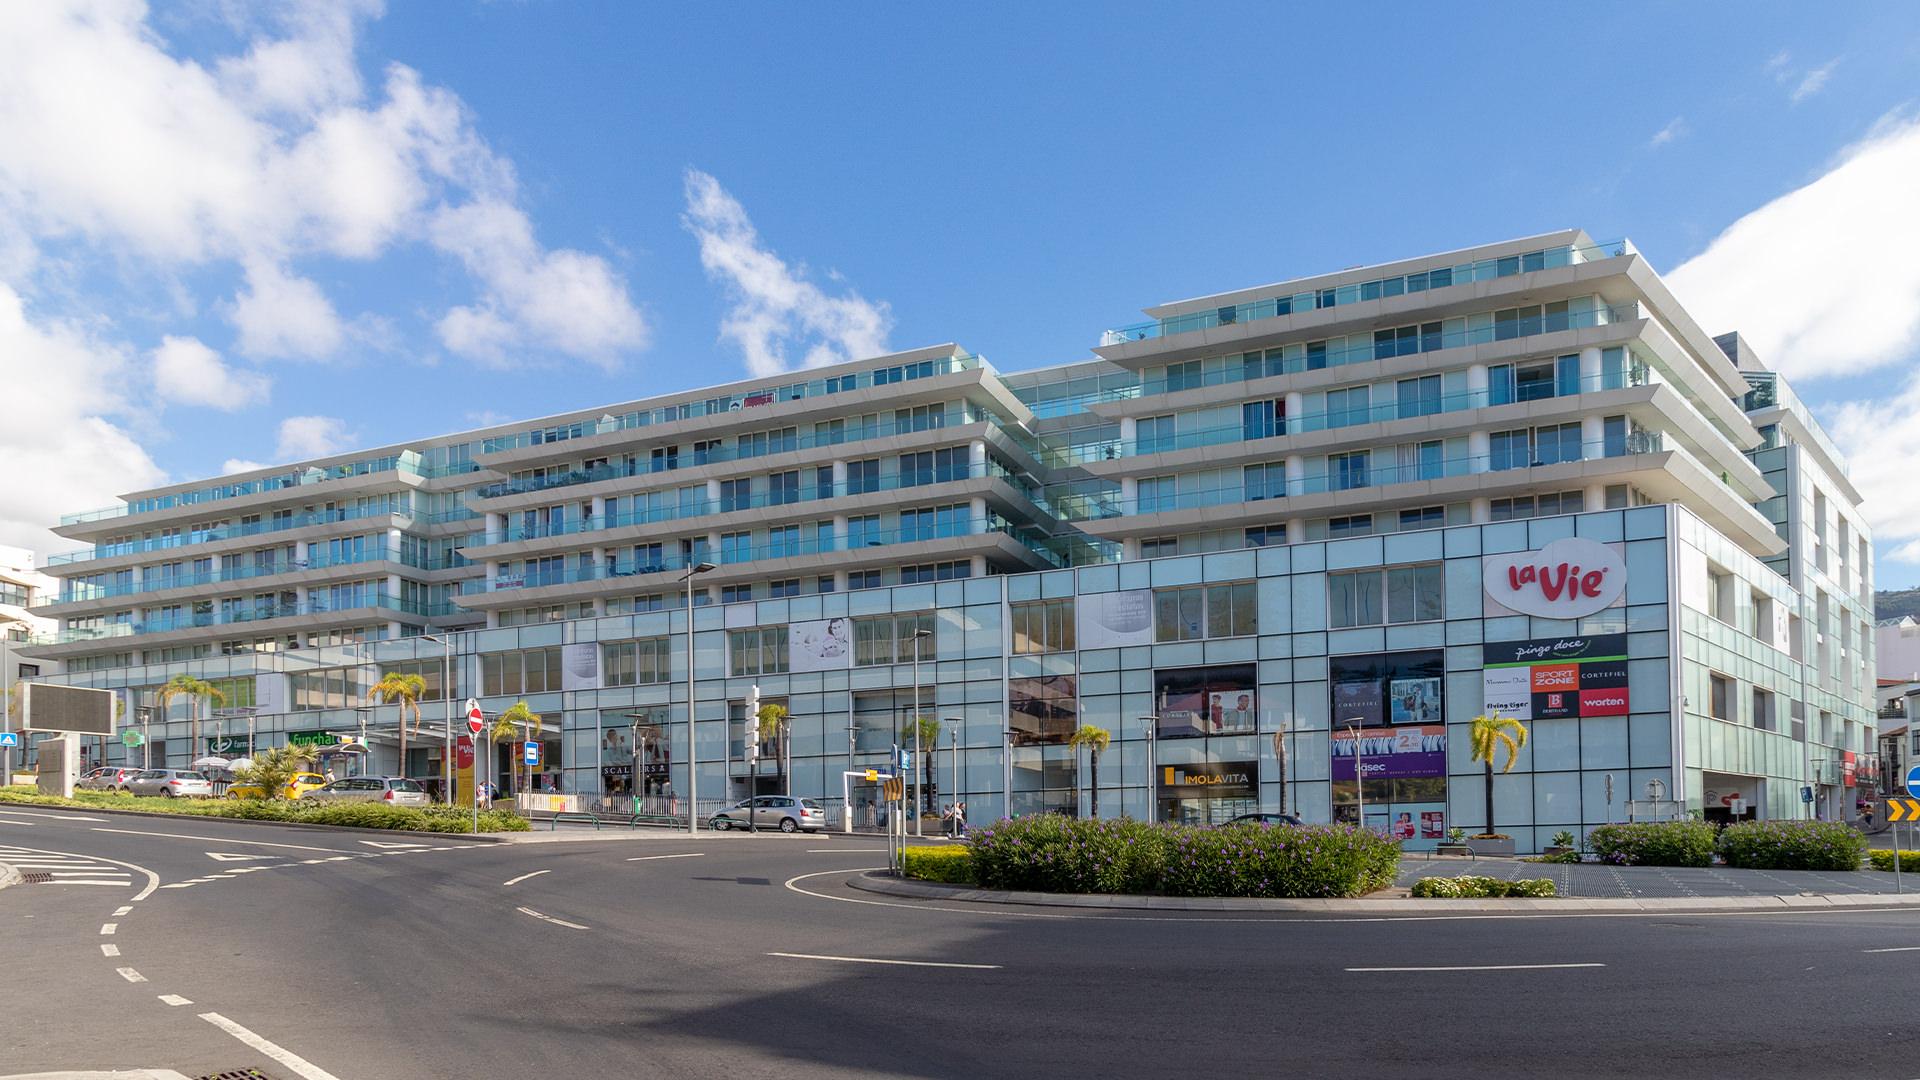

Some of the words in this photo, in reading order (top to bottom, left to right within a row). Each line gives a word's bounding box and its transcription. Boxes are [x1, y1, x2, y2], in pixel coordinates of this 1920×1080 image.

[1539, 562, 1603, 602] Vie
[1515, 645, 1550, 661] pingo
[1553, 640, 1584, 651] doce
[1535, 669, 1575, 679] SPORT
[1581, 671, 1626, 679] CORTEFIEL
[1535, 677, 1575, 686] ZONE
[1584, 697, 1624, 707] worten
[1185, 774, 1248, 784] IMOLAVITA
